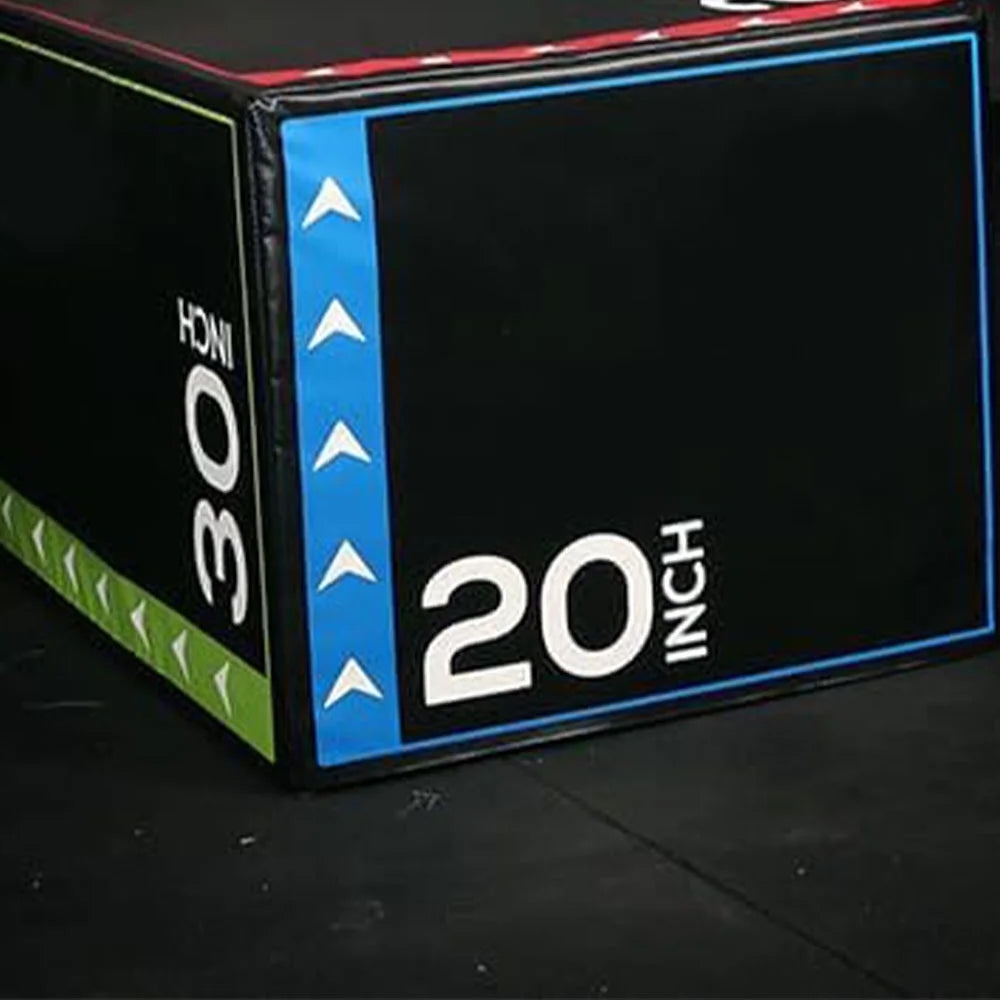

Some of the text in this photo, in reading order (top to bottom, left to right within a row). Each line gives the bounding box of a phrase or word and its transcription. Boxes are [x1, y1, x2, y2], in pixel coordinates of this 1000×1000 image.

[177, 297, 248, 626] 30 INCH
[421, 519, 708, 707] 20 INCH
